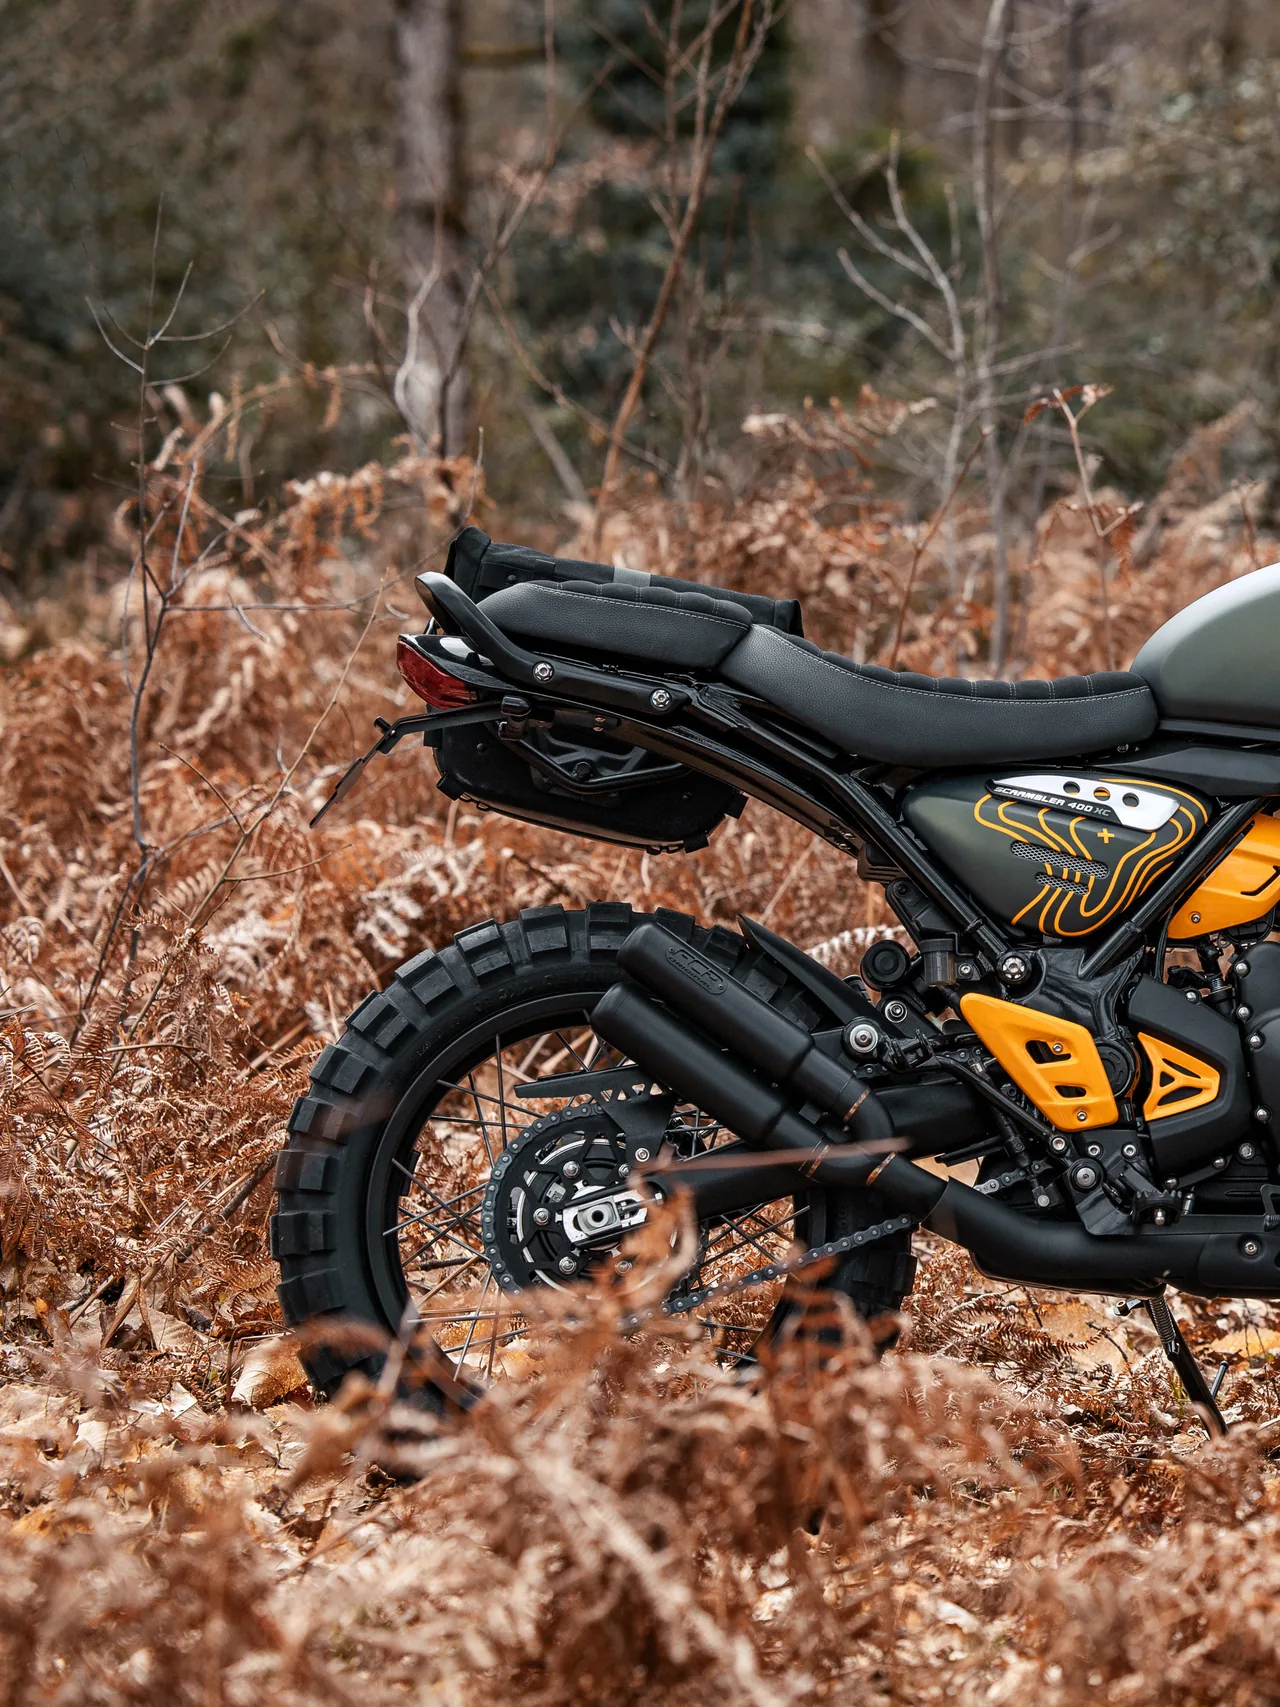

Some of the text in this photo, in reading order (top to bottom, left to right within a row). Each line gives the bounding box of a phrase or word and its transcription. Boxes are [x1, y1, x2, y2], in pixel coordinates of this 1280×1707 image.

[993, 786, 1112, 817] SCRAMBLER 400 XC
[668, 956, 713, 991] ORIGINAL
